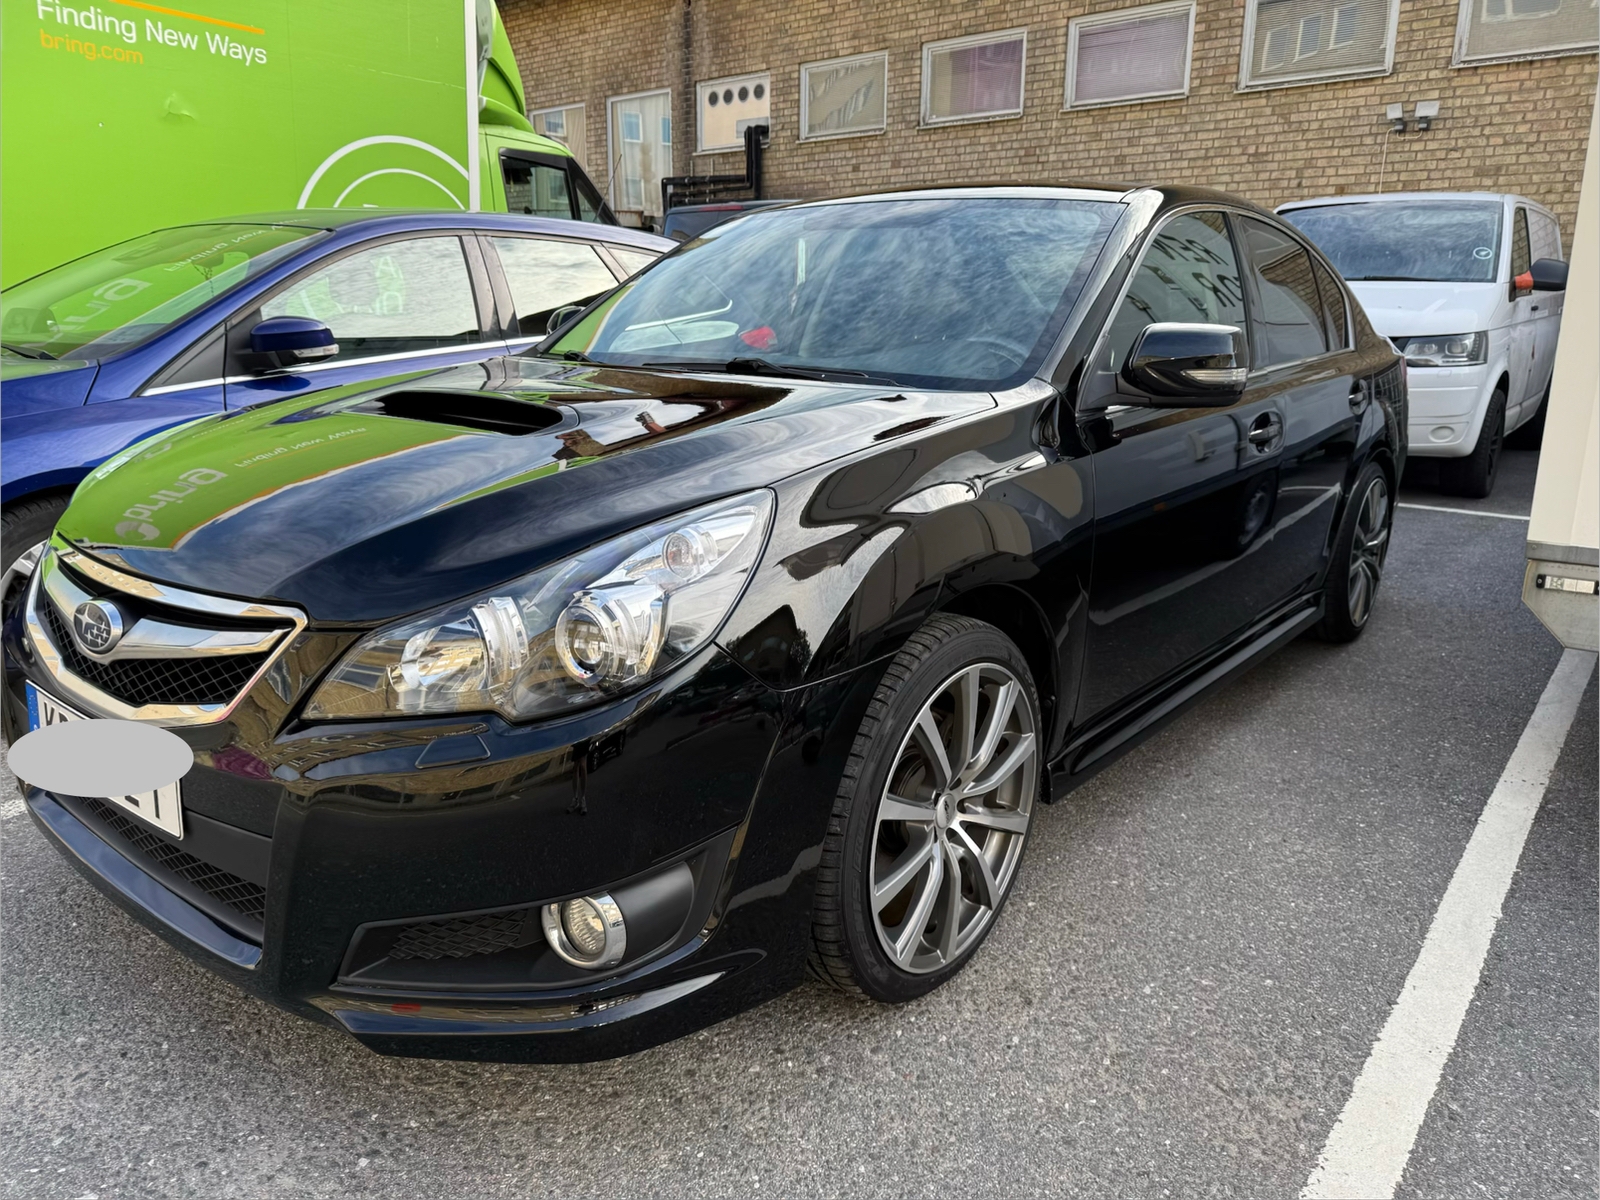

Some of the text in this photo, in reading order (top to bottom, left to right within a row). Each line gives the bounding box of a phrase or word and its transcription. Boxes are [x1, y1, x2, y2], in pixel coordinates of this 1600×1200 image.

[36, 0, 267, 66] Finding New Ways
[39, 28, 144, 65] bring.com
